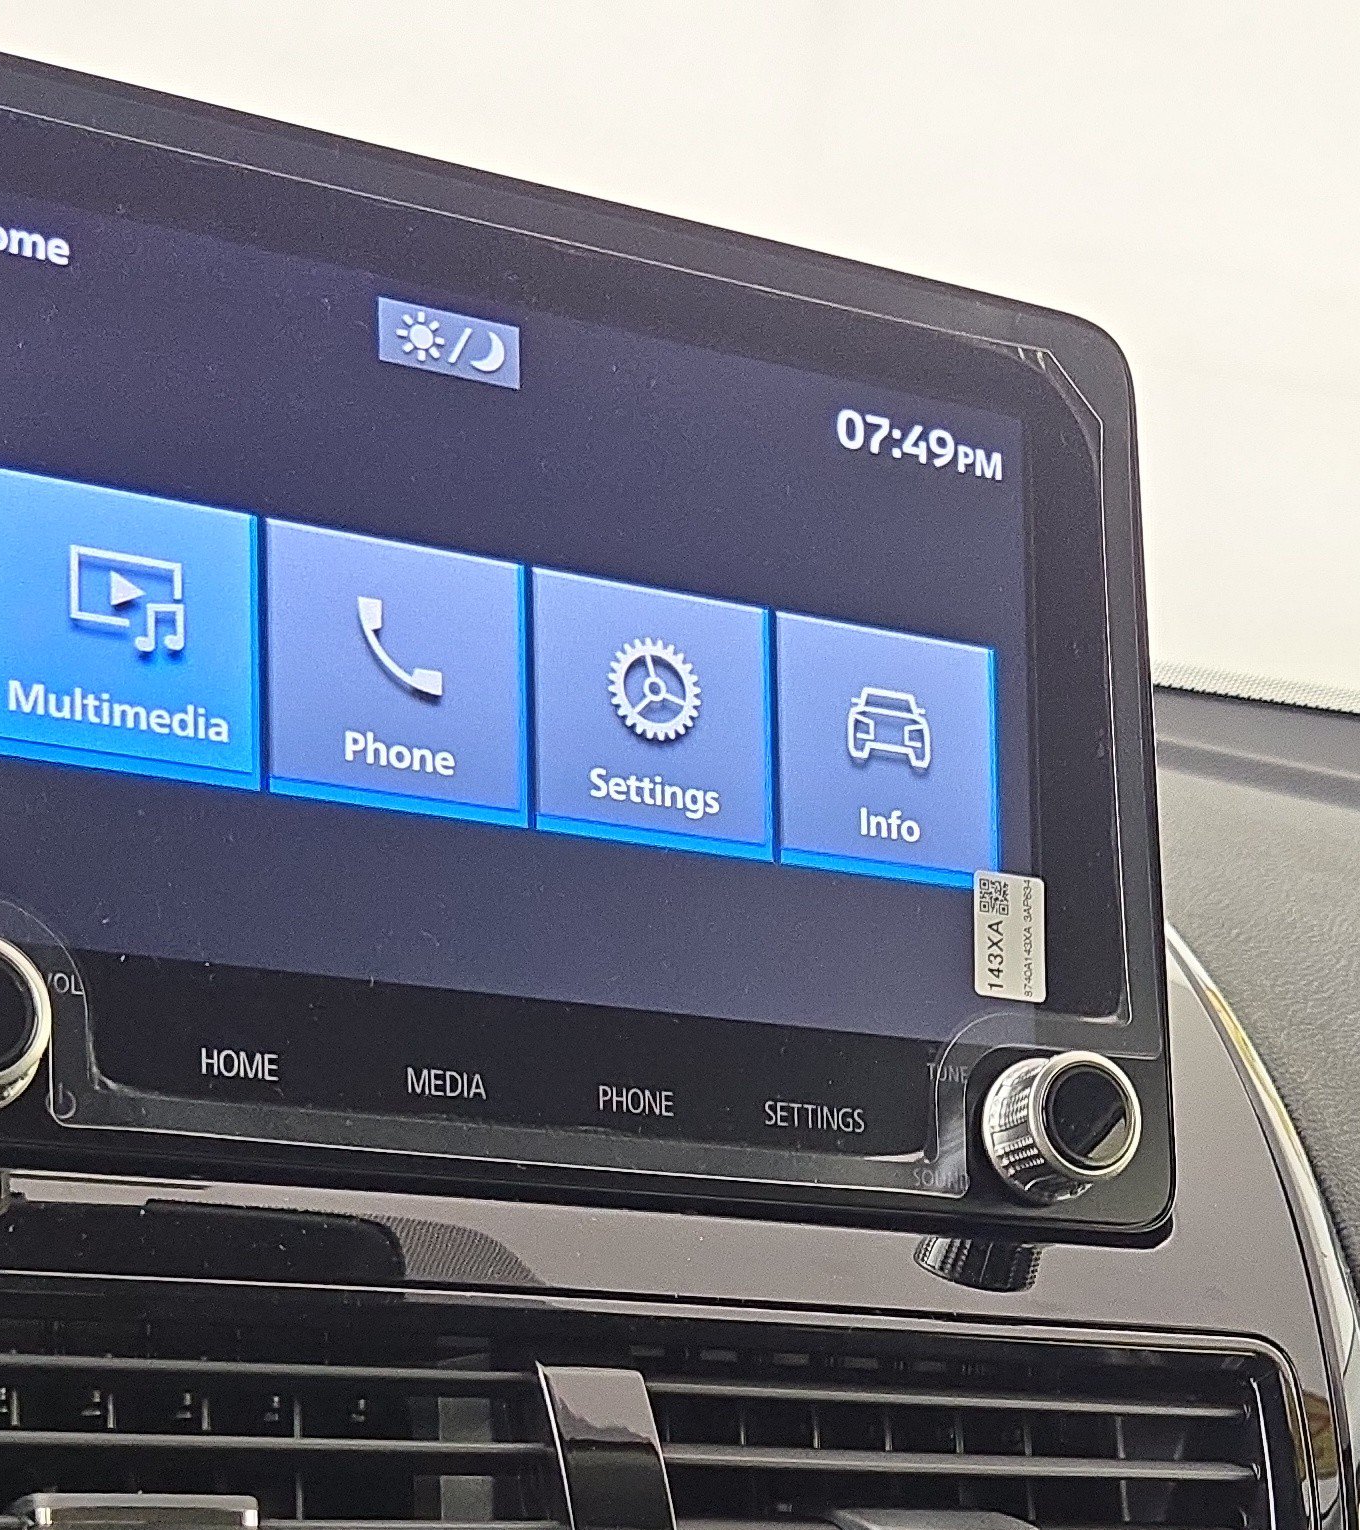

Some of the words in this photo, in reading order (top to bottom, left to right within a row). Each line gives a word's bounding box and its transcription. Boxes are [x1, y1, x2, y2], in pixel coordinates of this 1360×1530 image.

[7, 679, 230, 744] Multimedia
[343, 730, 456, 776] Phone
[589, 768, 721, 820] Settings
[859, 807, 921, 843] Info
[987, 920, 1004, 990] 143XA
[200, 1047, 279, 1082] HOME
[926, 1062, 969, 1084] TUNE
[406, 1066, 487, 1100] MEDIA
[598, 1085, 674, 1118] PHONE
[764, 1100, 865, 1134] SETTINGS
